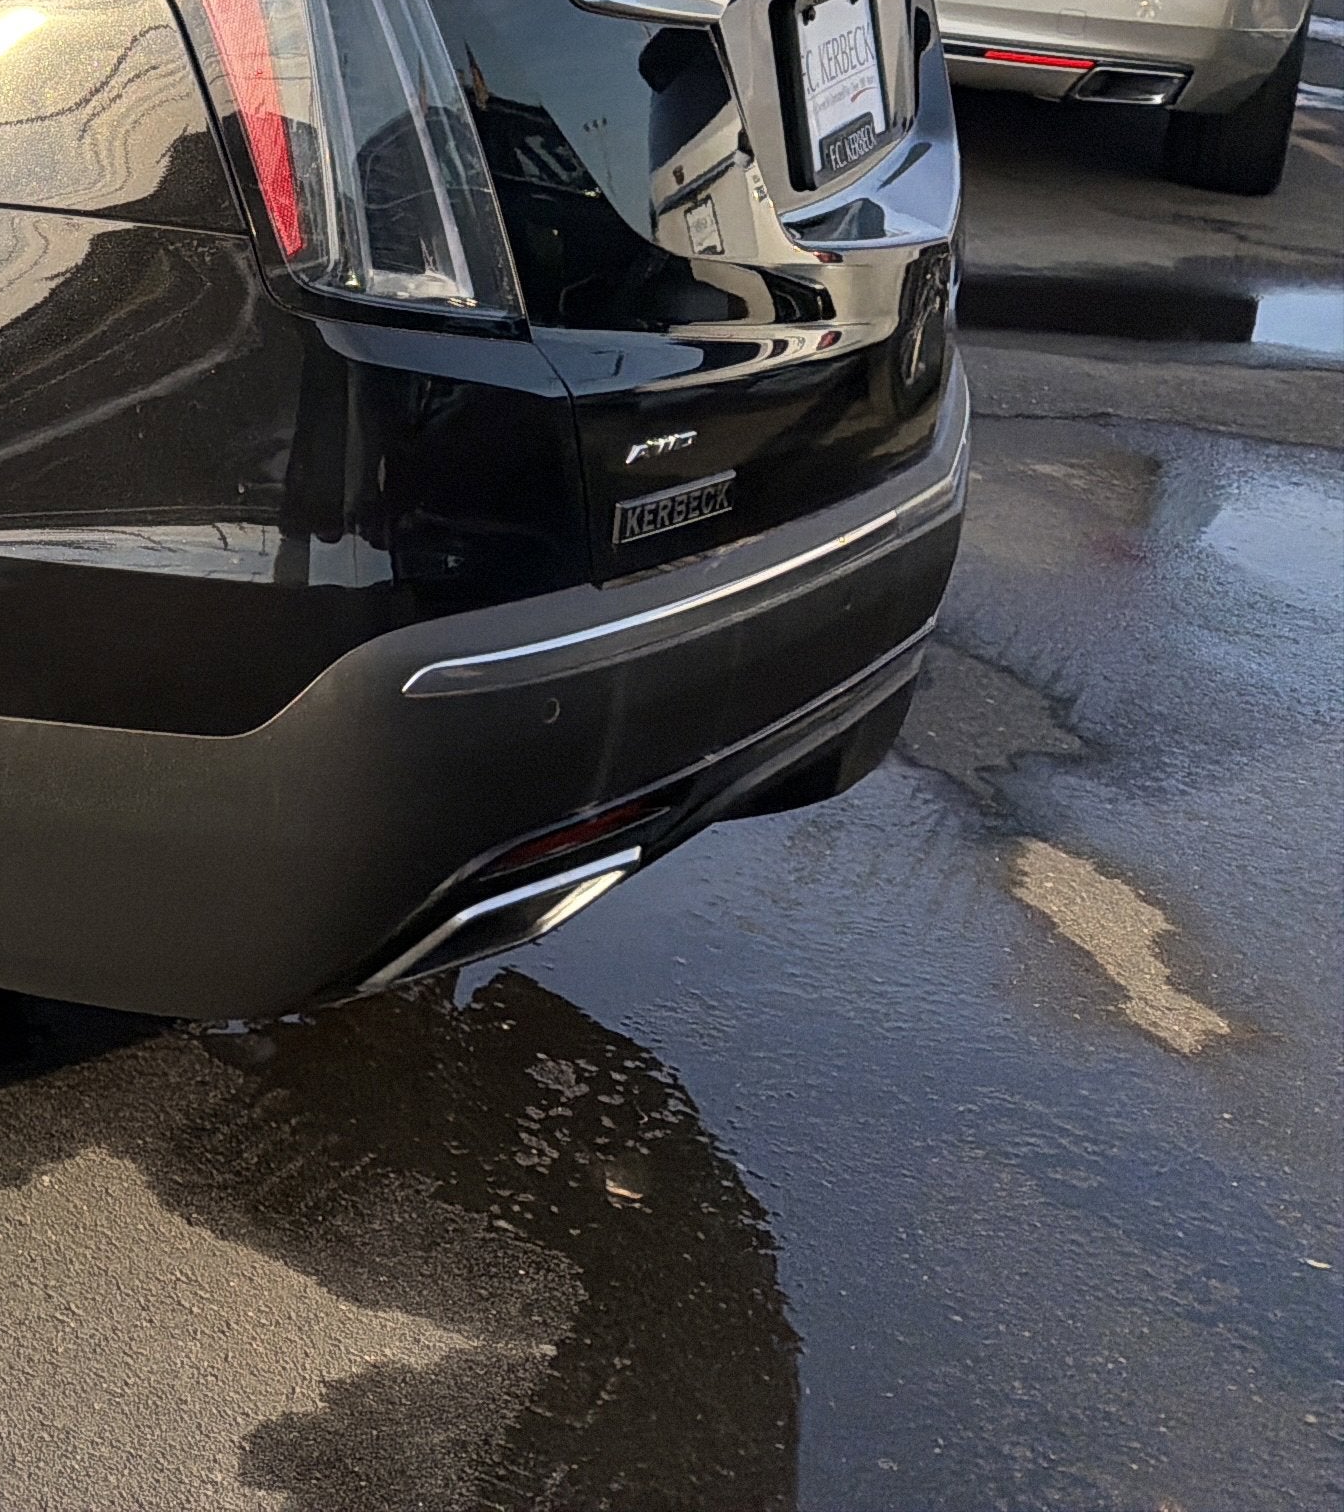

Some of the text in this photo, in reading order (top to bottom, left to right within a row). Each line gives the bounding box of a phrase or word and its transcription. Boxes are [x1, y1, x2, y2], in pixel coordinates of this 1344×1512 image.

[817, 24, 874, 84] KERBECK
[844, 124, 878, 164] KERBECK
[625, 481, 730, 538] KERBECK
